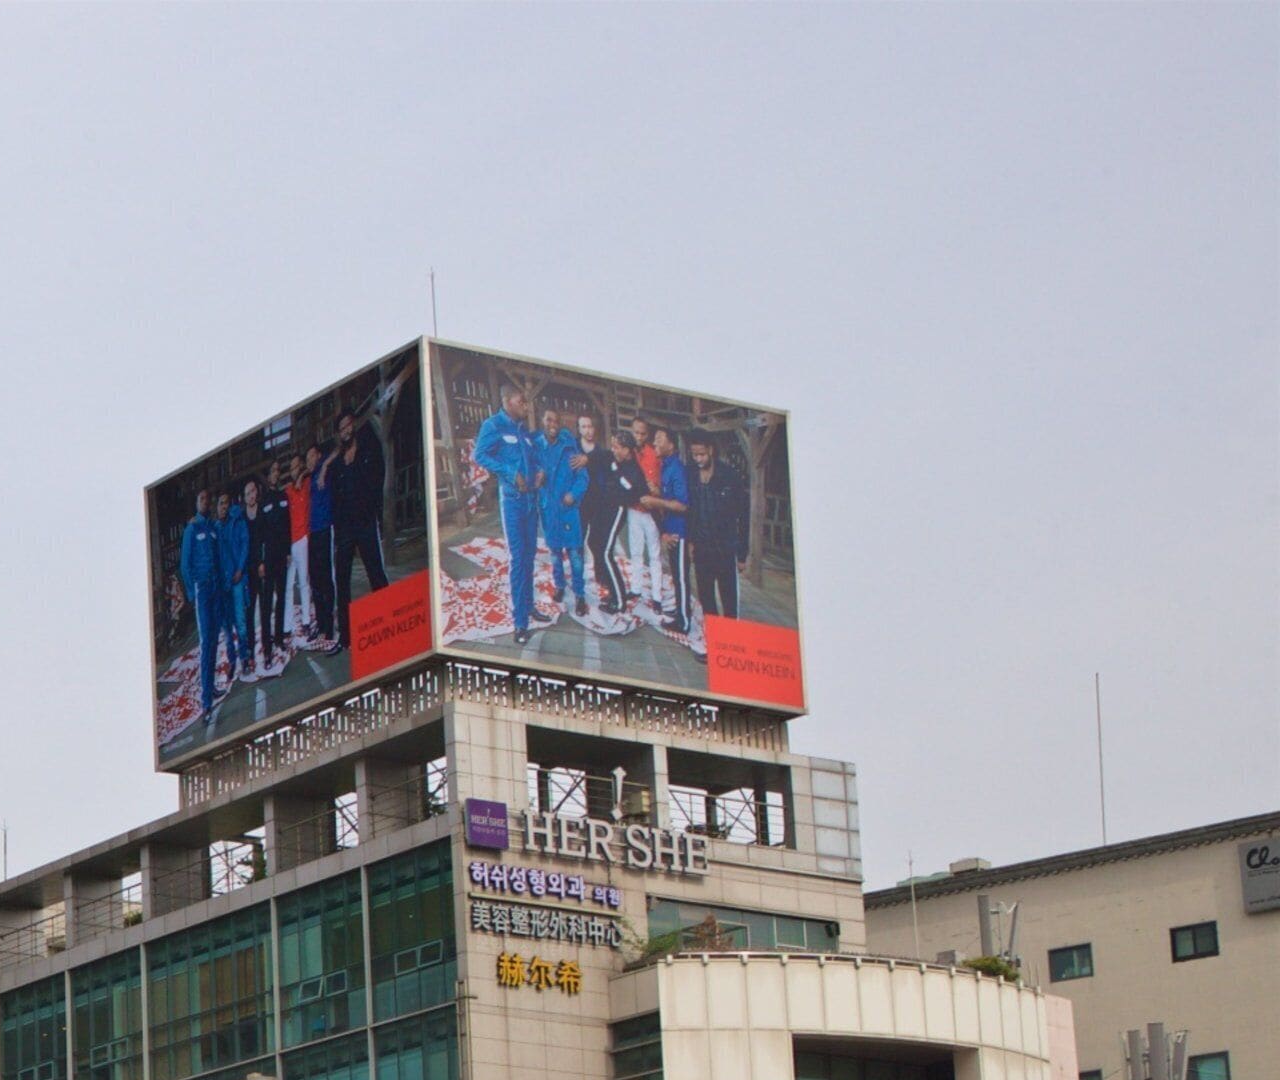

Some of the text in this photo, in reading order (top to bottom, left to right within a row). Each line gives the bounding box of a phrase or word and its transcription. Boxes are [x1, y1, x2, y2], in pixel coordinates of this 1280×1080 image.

[359, 612, 426, 651] CALVIN KLEIN
[716, 654, 760, 673] CALVIN
[762, 662, 796, 680] KLEIN
[625, 824, 710, 875] SHE
[470, 861, 624, 907] 허쉬성형외과 의원
[471, 902, 624, 948] 美容整形外科中心
[497, 952, 583, 996] 赫尔希
